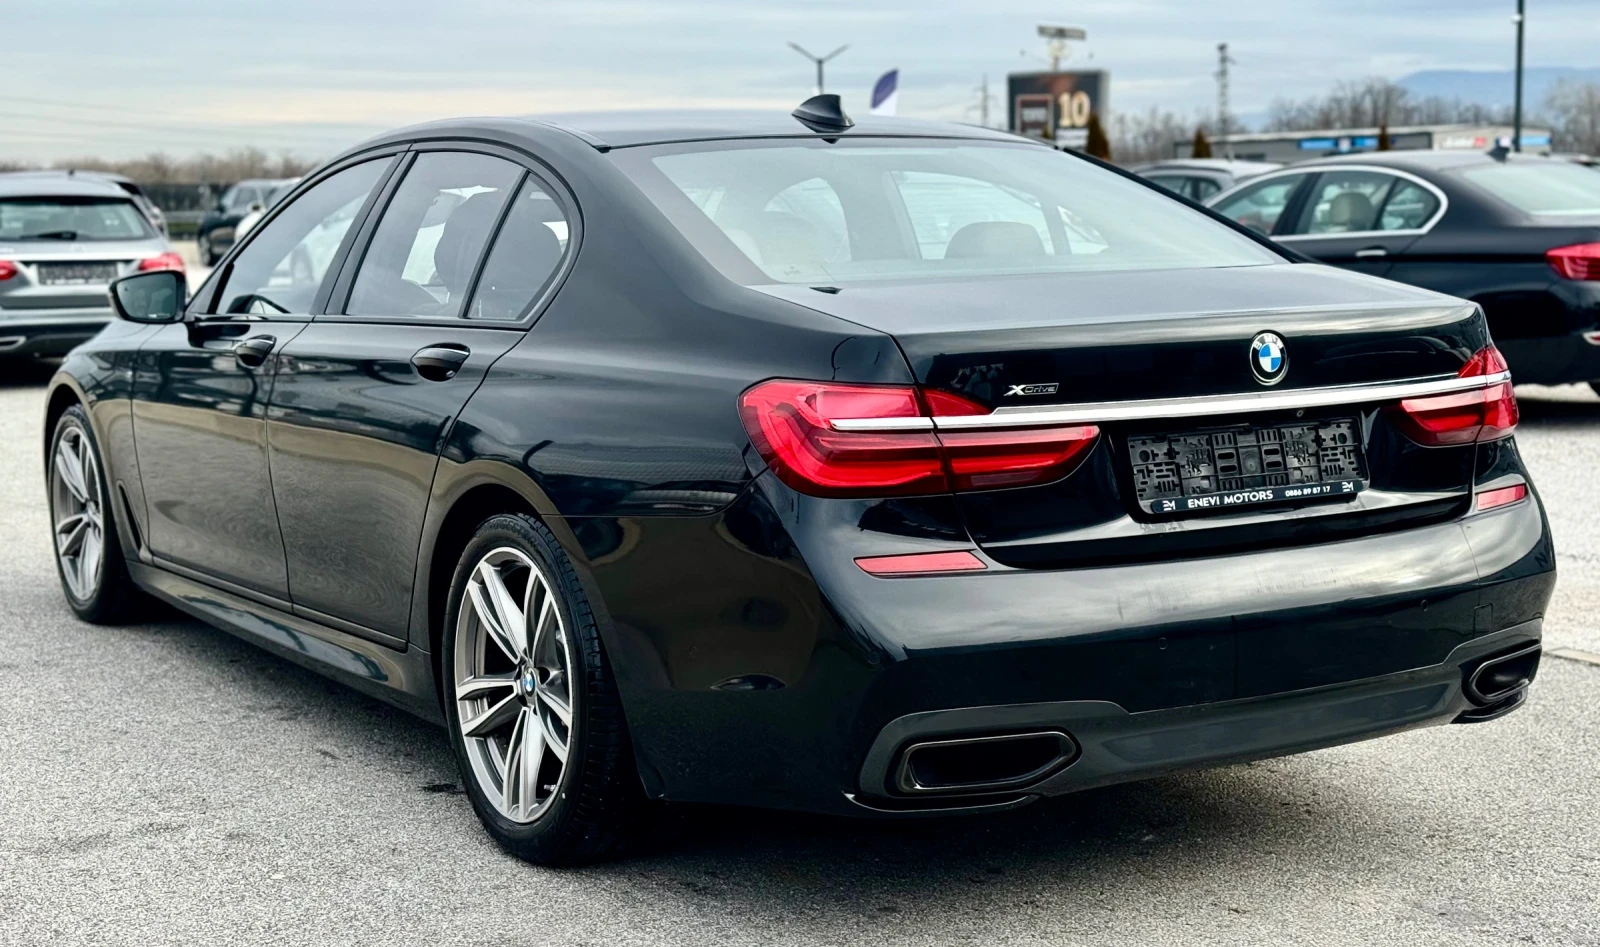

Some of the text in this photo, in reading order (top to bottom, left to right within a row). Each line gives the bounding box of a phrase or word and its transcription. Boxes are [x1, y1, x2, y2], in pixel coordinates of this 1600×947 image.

[1059, 92, 1090, 127] 10
[1253, 334, 1284, 350] BMW
[1187, 496, 1220, 508] ENEVI
[1224, 490, 1273, 504] MOTORS
[1285, 488, 1302, 497] 0886
[1303, 487, 1312, 495] 89
[1312, 486, 1321, 494] 87
[1322, 485, 1331, 493] 17
